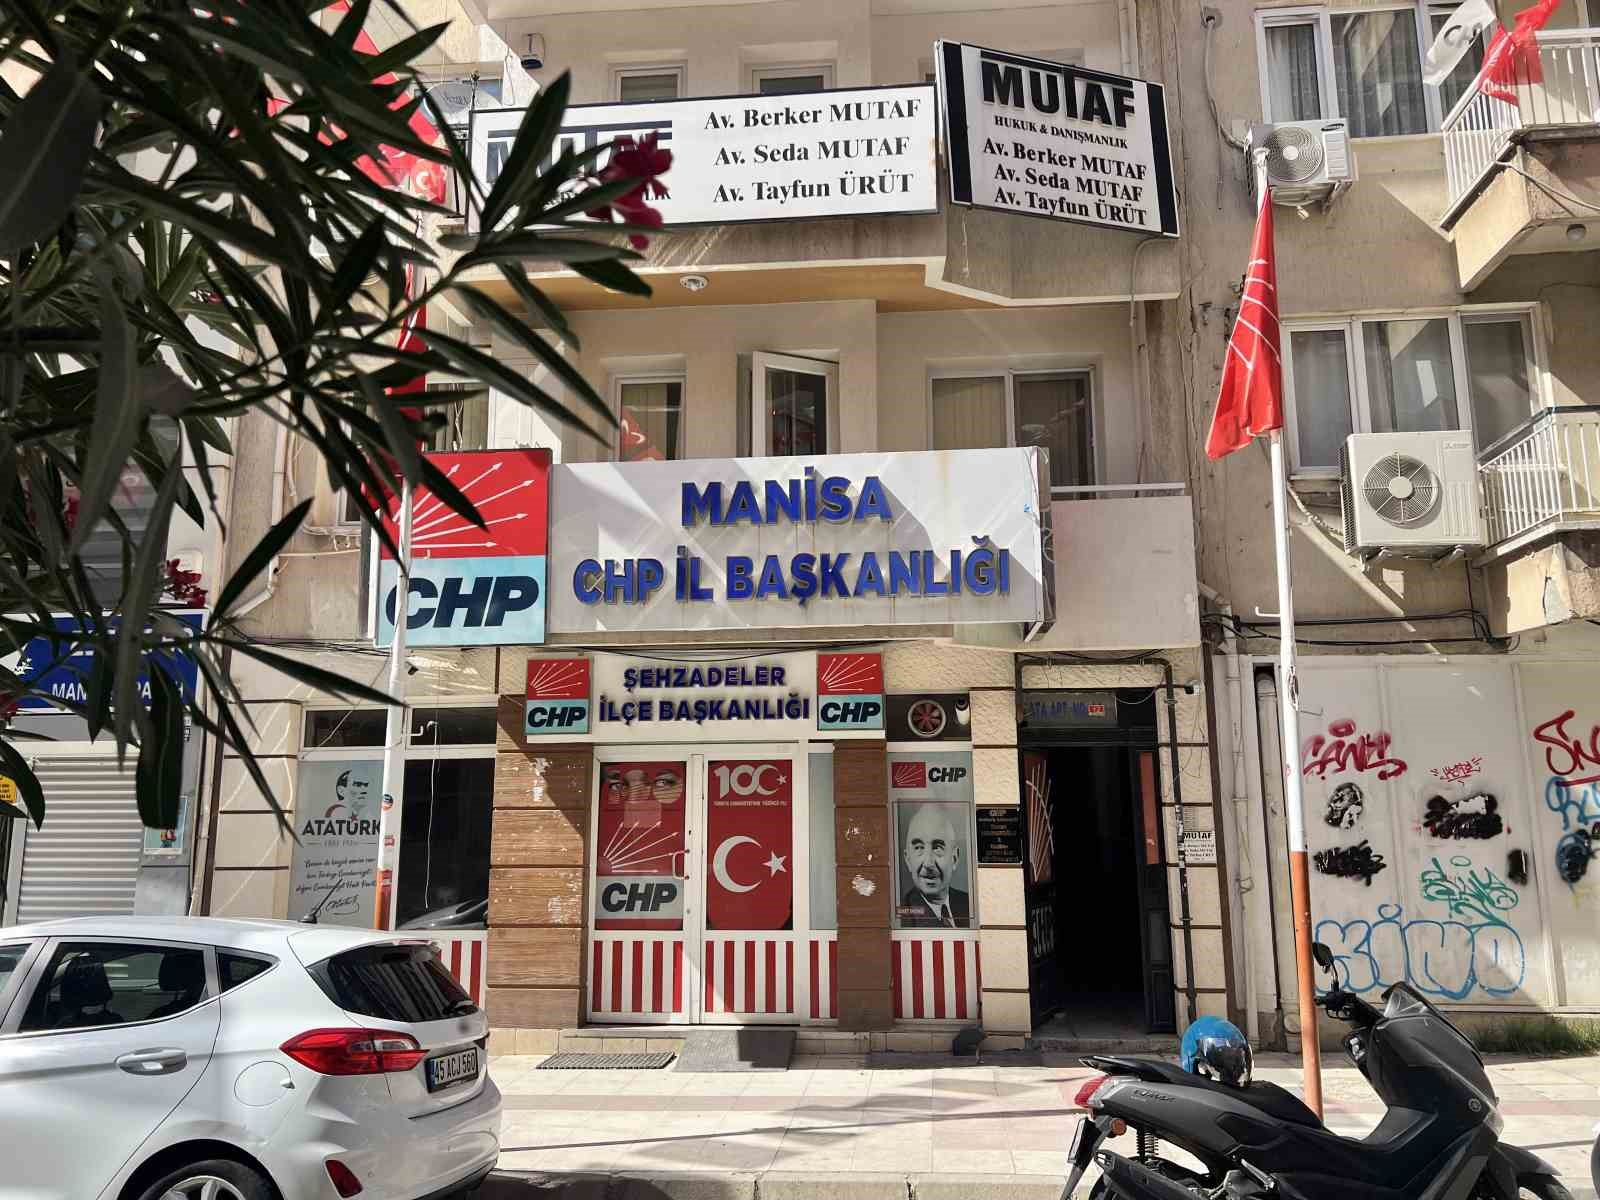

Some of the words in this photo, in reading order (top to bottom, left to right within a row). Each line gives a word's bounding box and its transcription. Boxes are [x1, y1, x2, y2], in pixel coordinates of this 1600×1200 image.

[980, 59, 1136, 129] MUTAF
[704, 110, 735, 130] Av.
[743, 105, 822, 129] Berker
[829, 98, 922, 123] MUTAF
[994, 115, 1038, 134] HUKUK
[1039, 124, 1049, 135] &
[1050, 126, 1128, 149] DANIŞMANLIK
[714, 147, 746, 167] Av.
[752, 142, 809, 164] Seda
[817, 136, 910, 161] MUTAF
[983, 137, 1009, 157] Av.
[1013, 142, 1077, 169] Berker
[1081, 154, 1147, 181] MUTAF
[713, 184, 744, 204] Av.
[752, 178, 831, 205] Tayfun
[839, 170, 914, 198] ÜRÜT
[994, 164, 1021, 183] Av.
[1025, 168, 1070, 191] Seda
[1076, 175, 1143, 202] MUTAF
[994, 187, 1021, 206] Av.
[1025, 191, 1089, 218] Tayfun
[1095, 199, 1147, 226] ÜRÜT
[681, 466, 893, 528] MANİSA
[573, 558, 664, 606] CHP
[676, 545, 715, 603] İL
[726, 535, 1010, 608] BAŞKANLIĞI
[385, 575, 540, 629] CHP
[623, 664, 787, 693] ŞEHZADELER
[527, 706, 587, 728] CHP
[599, 695, 653, 726] İLÇE
[658, 691, 810, 726] BAŞKANLIĞI
[820, 702, 882, 724] CHP
[928, 767, 967, 783] CHP
[601, 882, 677, 913] CHP
